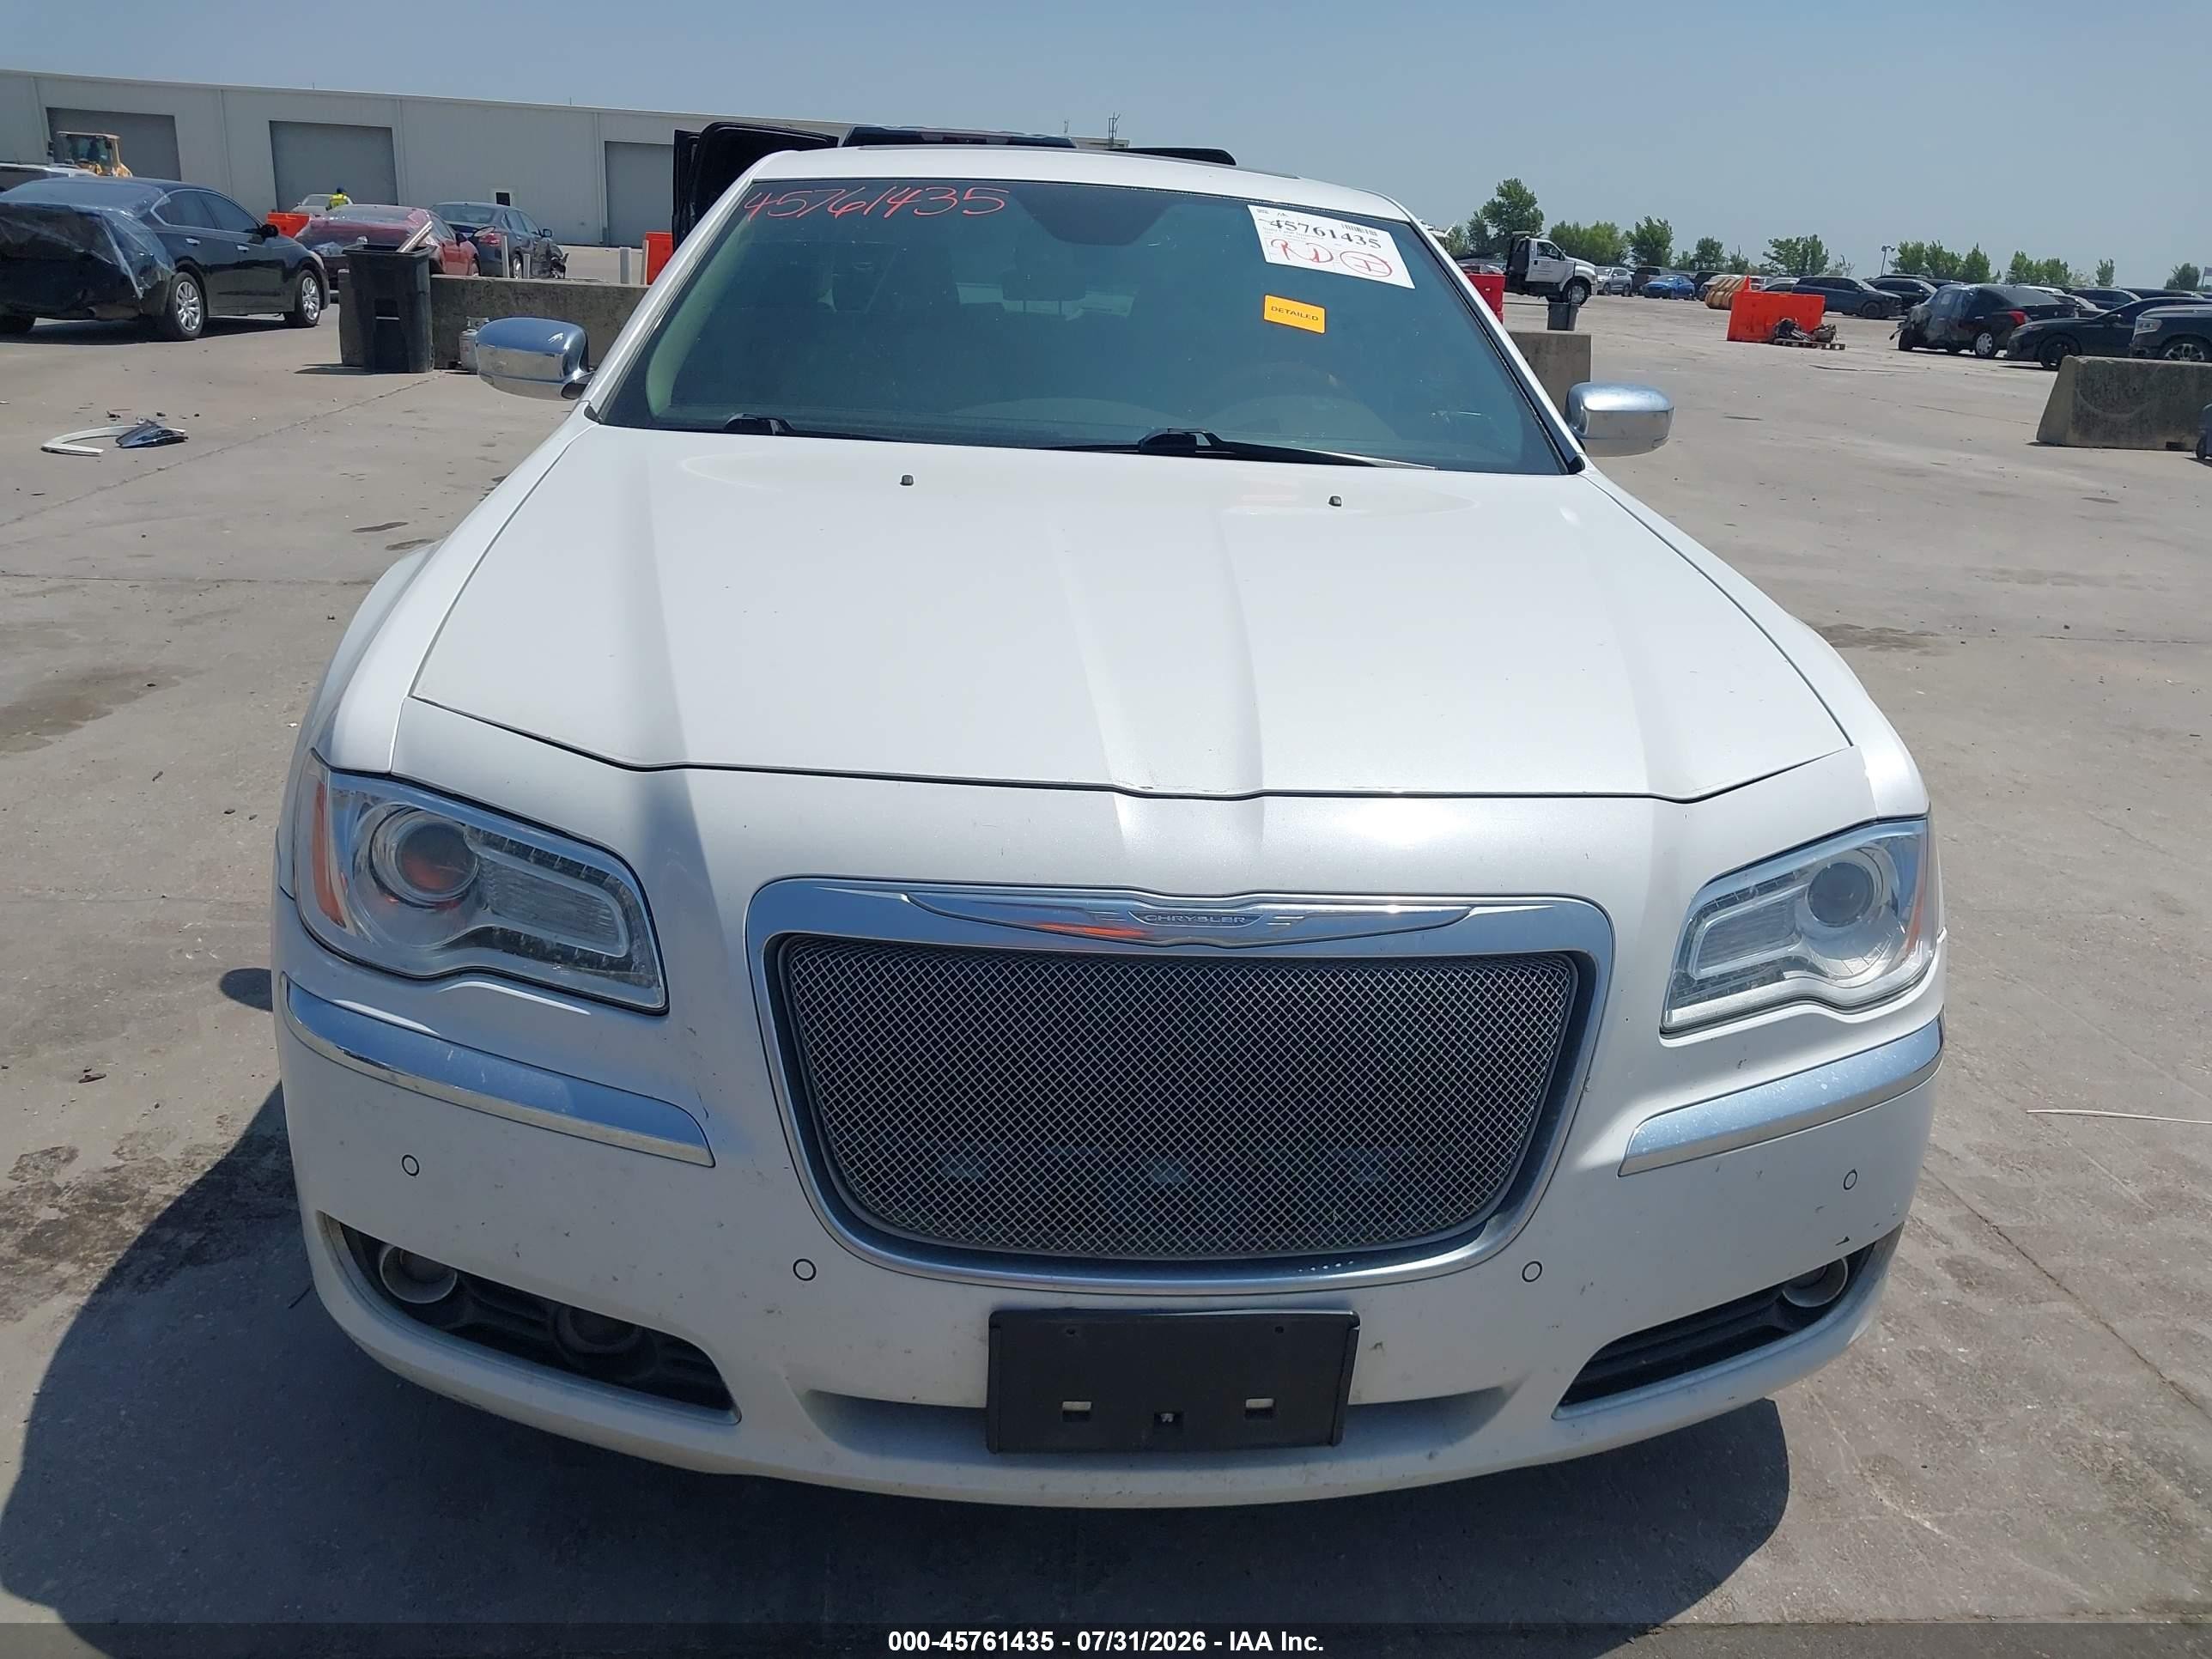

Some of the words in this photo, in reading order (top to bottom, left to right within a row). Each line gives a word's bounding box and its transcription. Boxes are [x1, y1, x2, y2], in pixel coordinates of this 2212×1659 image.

[744, 186, 1010, 222] 45761435
[1269, 219, 1382, 249] 45761435
[1270, 305, 1319, 321] DETAILED
[1144, 914, 1246, 924] CHRYSLER
